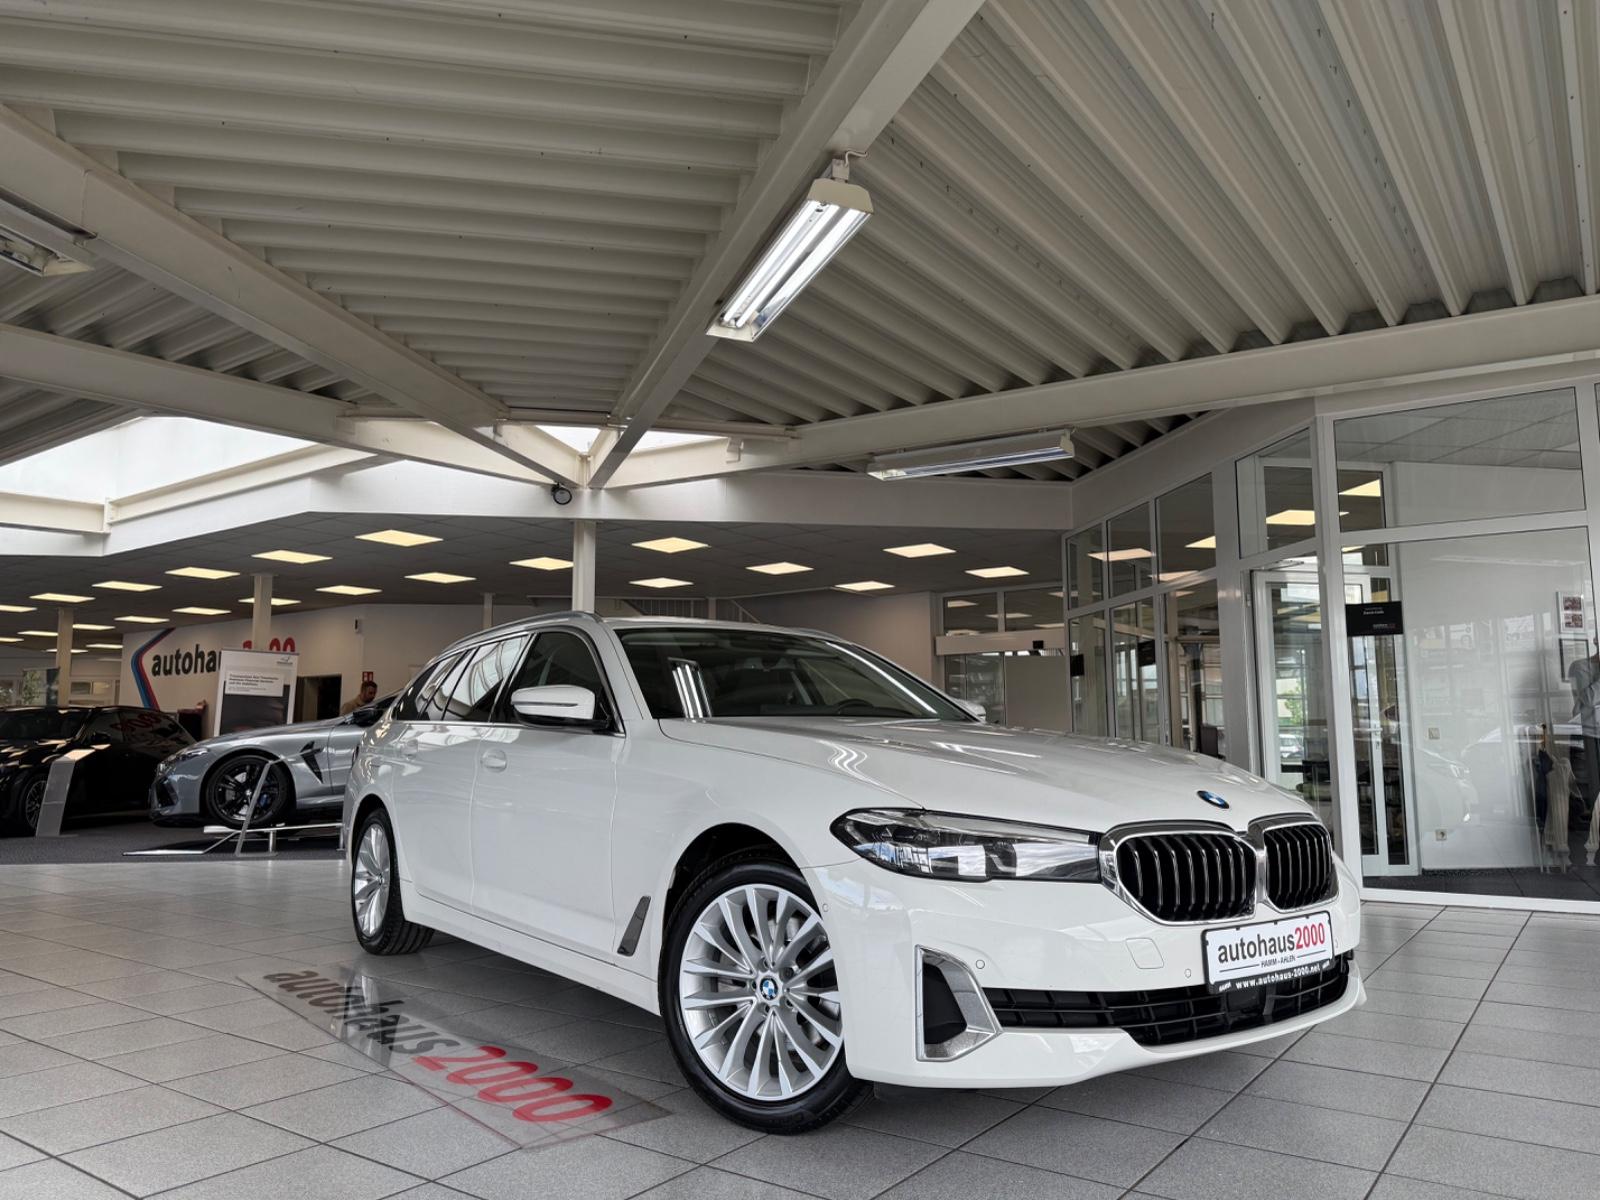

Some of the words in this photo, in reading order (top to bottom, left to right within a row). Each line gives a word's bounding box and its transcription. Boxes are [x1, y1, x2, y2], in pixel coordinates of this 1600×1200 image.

[1218, 923, 1325, 963] autohaus2000
[1235, 963, 1320, 989] www.autohaus-2000.net
[263, 970, 613, 1122] autohaus2000
